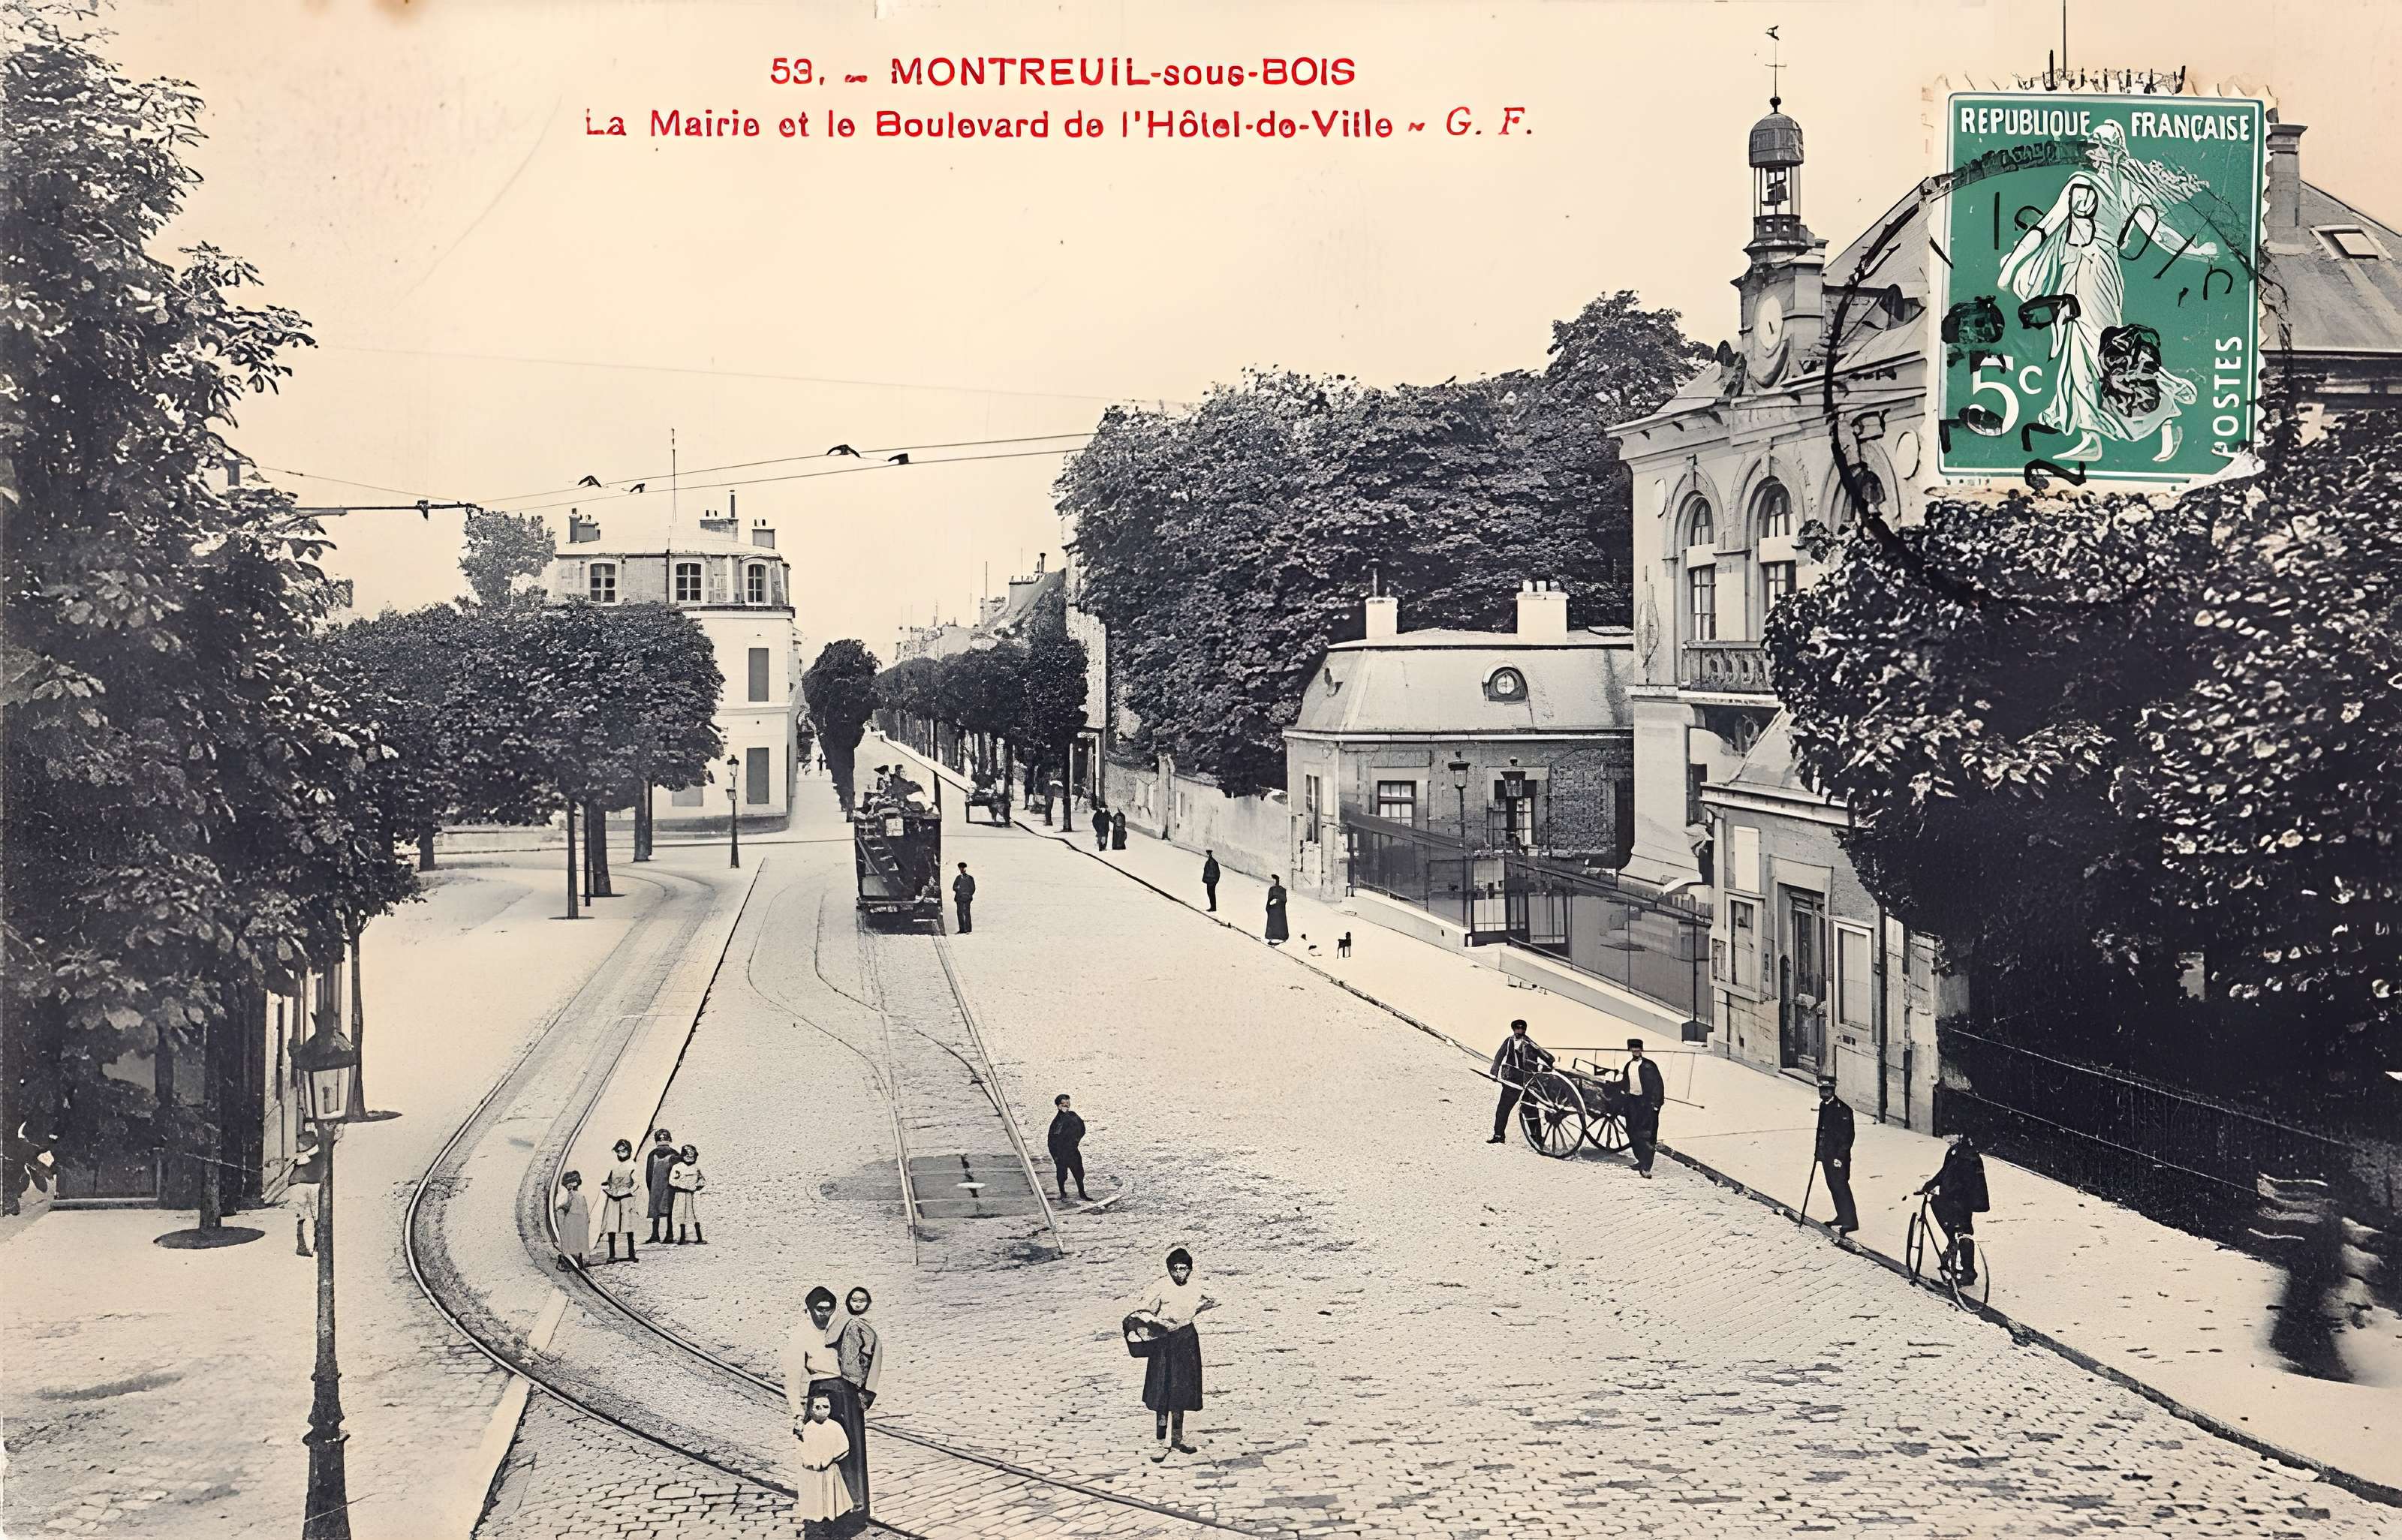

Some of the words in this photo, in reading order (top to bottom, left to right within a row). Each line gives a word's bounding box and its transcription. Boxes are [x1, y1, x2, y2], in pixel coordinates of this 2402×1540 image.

[1961, 107, 2091, 141] REPUBLIQUE
[2131, 112, 2250, 143] FRANÇAISE
[2211, 335, 2244, 458] POSTES
